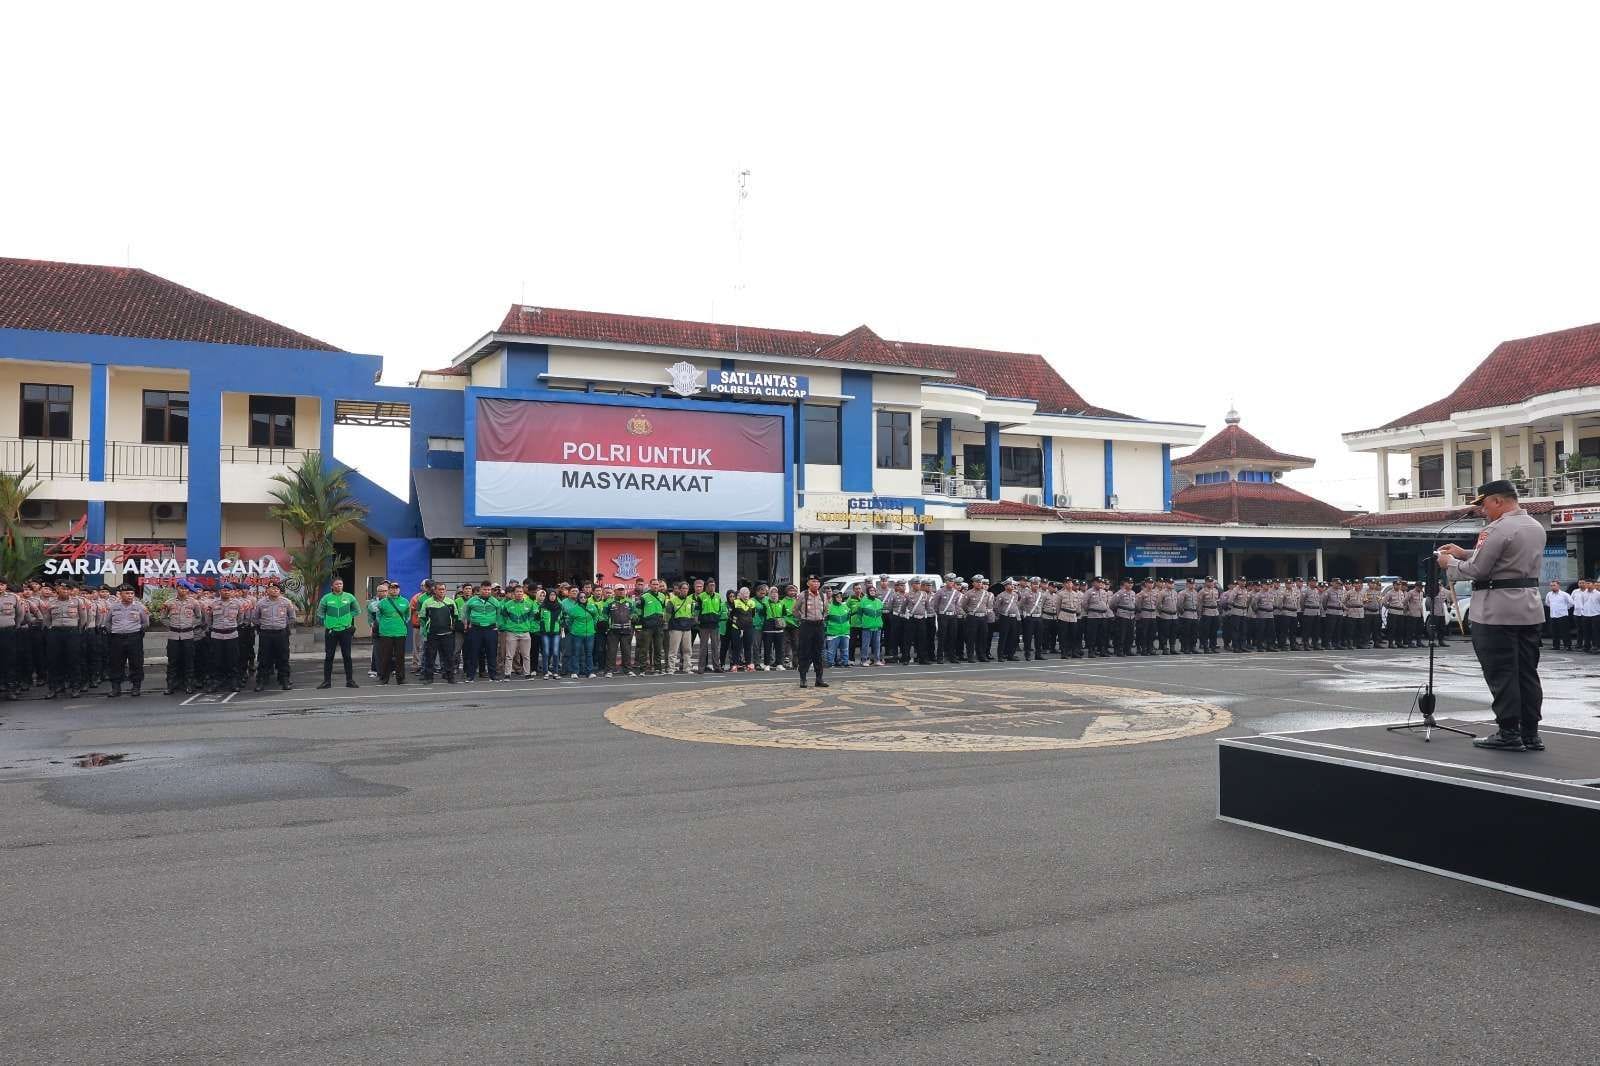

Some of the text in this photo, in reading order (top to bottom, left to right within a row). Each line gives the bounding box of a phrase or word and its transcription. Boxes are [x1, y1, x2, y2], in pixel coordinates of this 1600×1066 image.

[720, 371, 797, 388] SATLANTAS
[711, 384, 807, 398] POLRESTA CILACAP
[563, 442, 712, 466] POLRI UNTUK
[561, 470, 713, 492] MASYARAKAT
[43, 559, 280, 576] SARJA ARYA RACANA
